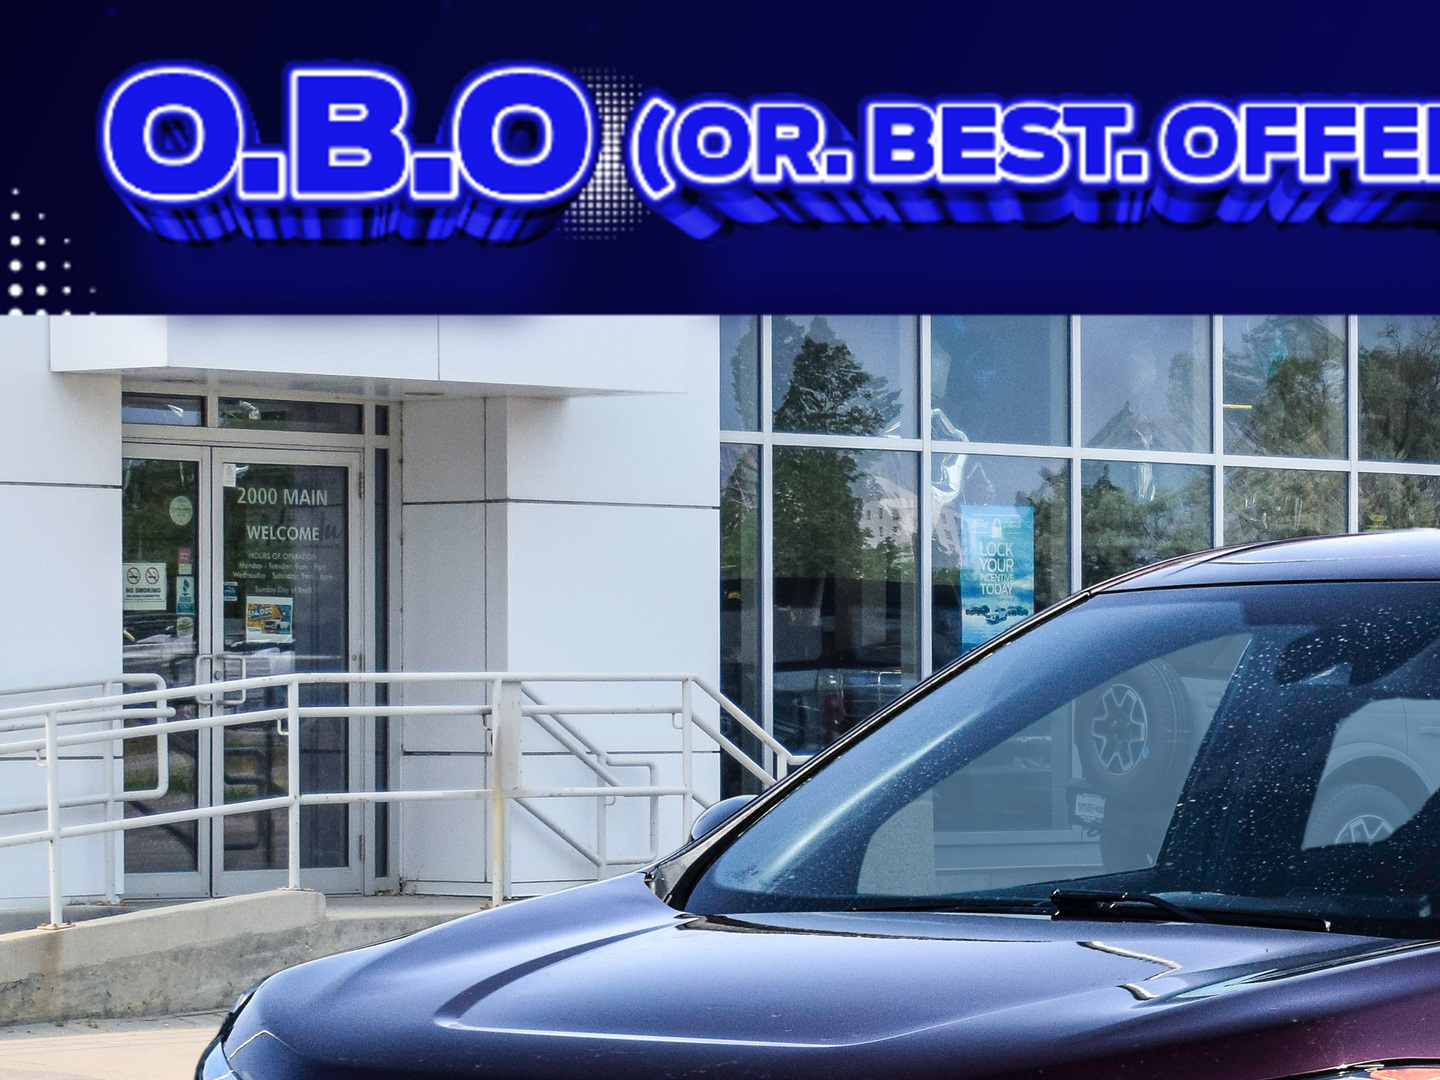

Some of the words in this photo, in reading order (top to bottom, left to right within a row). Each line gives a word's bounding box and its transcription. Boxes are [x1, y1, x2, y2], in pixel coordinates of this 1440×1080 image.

[237, 487, 278, 505] 2000
[283, 488, 328, 506] MAIN
[247, 525, 320, 542] WELCOME
[980, 541, 1014, 557] LOCK
[980, 558, 1014, 572] YOUR
[980, 573, 1014, 582] INCENTIVE
[980, 583, 1013, 595] TODAY
